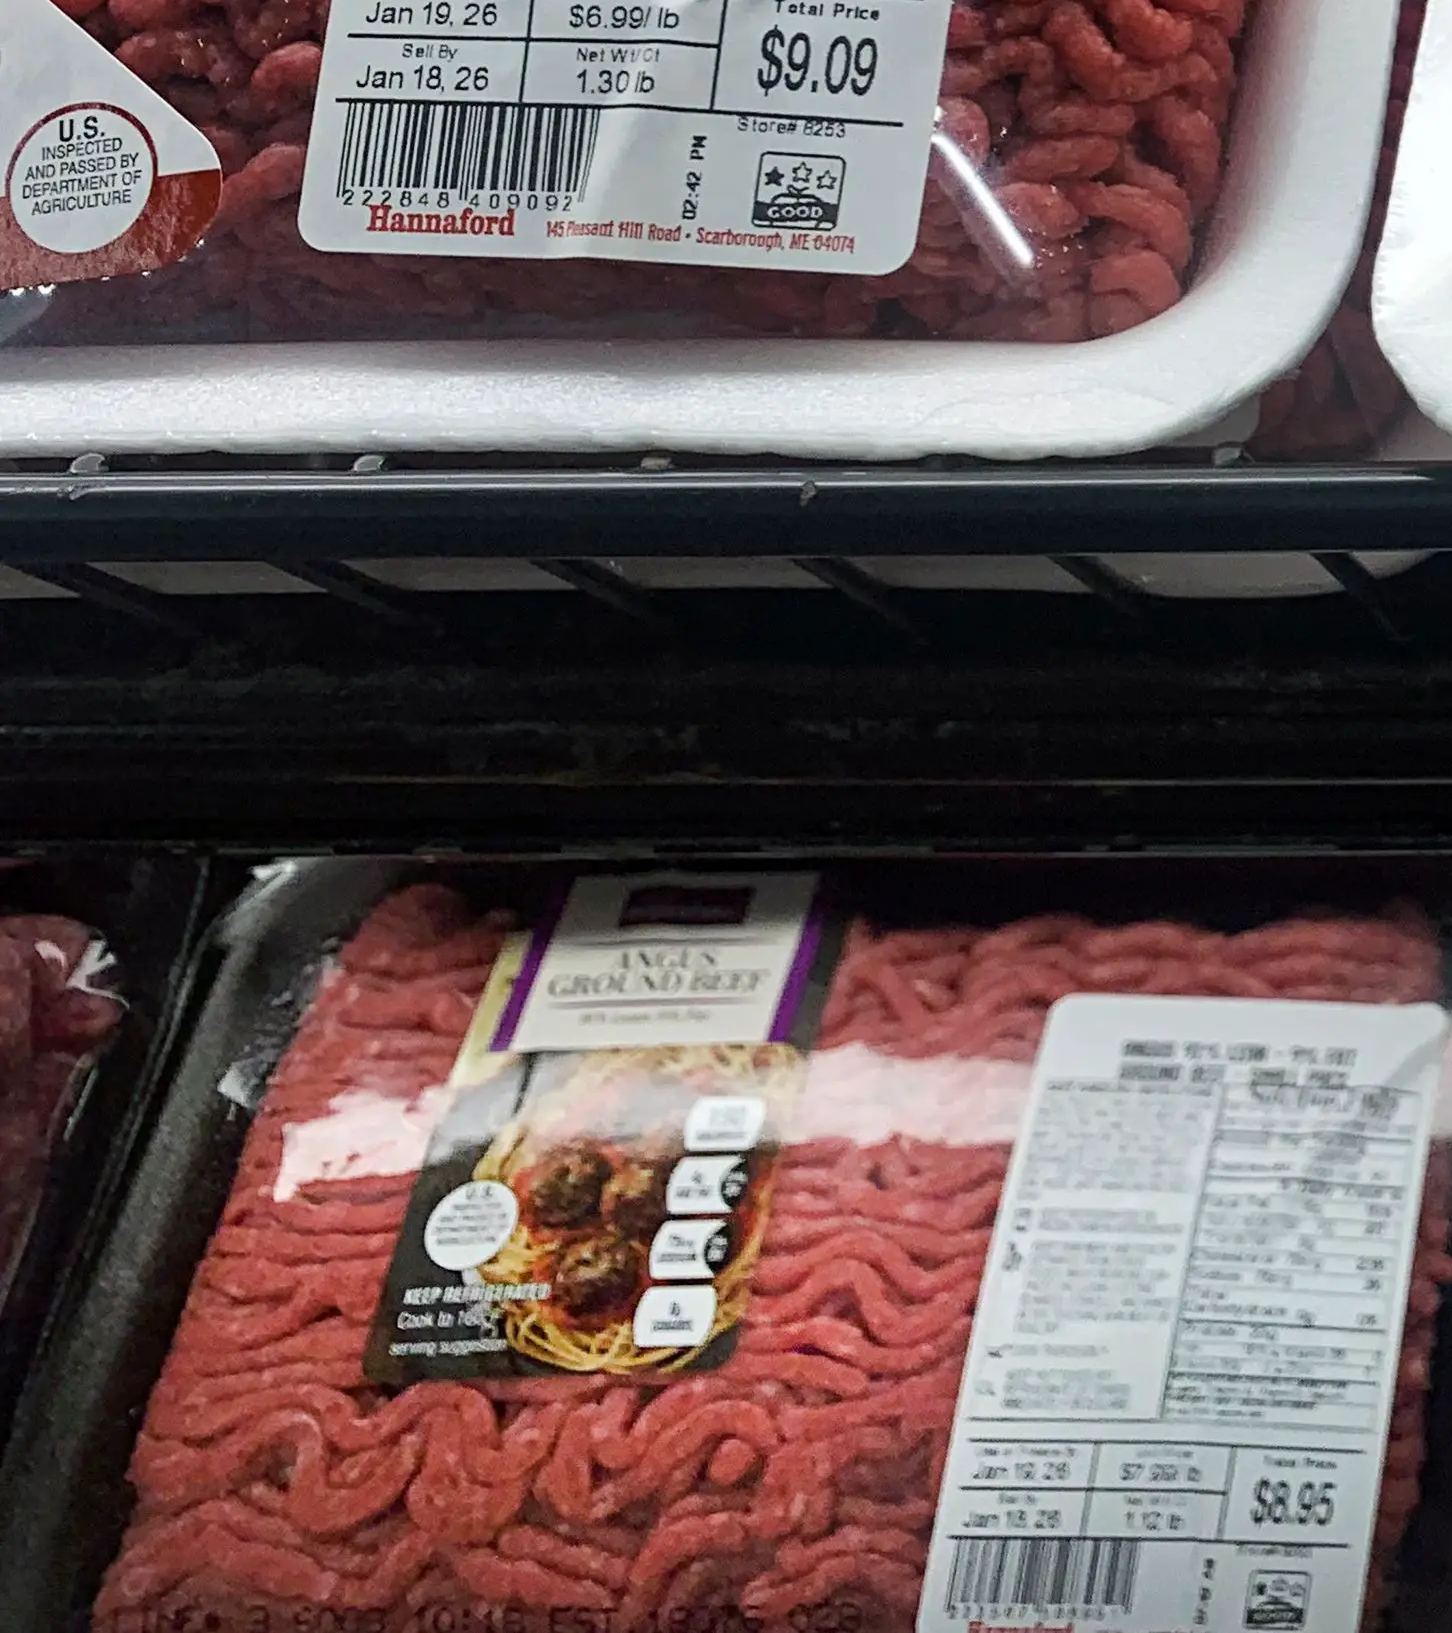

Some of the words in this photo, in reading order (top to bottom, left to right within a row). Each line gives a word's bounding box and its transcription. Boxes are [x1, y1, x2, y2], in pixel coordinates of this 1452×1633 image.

[365, 2, 419, 27] Jan
[425, 2, 455, 30] 19,
[461, 3, 499, 27] 26
[569, 3, 653, 31] $6.99/
[656, 4, 680, 30] lb
[775, 0, 824, 18] Total
[831, 4, 881, 22] Price
[757, 25, 878, 99] $9.09
[356, 67, 410, 92] Jan
[414, 67, 446, 93] 18,
[452, 67, 490, 92] 26
[577, 70, 630, 94] 1.30
[635, 71, 655, 94] lb
[59, 116, 105, 142] U.S.
[42, 138, 123, 161] INSPECTED
[25, 164, 58, 181] AND
[60, 156, 117, 176] PASSED
[120, 153, 139, 169] BY
[22, 173, 119, 199] DEPARTMENT
[122, 170, 143, 187] OF
[32, 190, 132, 215] AGRICULTURE
[368, 206, 516, 237] Hannaford
[548, 971, 682, 997] GROUND
[689, 969, 769, 995] BEEF
[1250, 1477, 1337, 1529] $8.95
